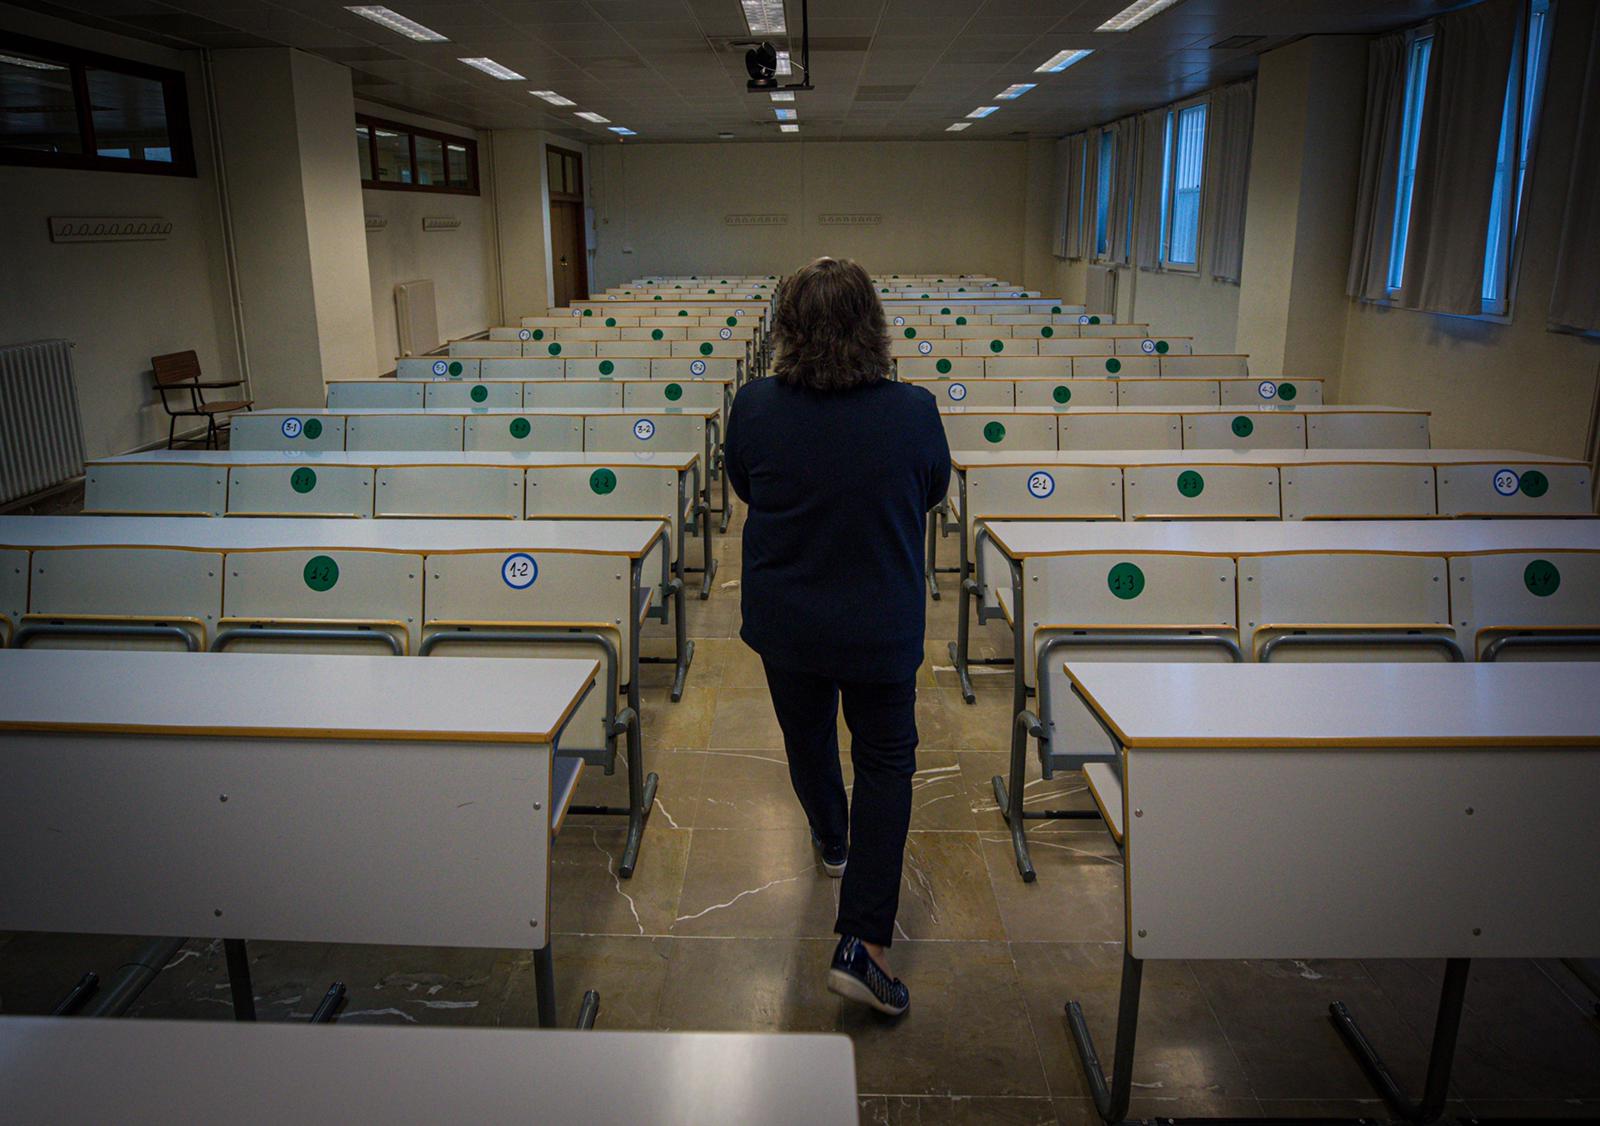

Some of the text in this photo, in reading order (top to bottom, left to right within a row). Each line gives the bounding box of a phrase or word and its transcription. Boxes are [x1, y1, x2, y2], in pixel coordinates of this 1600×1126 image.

[285, 422, 297, 432] 3-1
[637, 424, 651, 434] 3-2
[1032, 477, 1047, 490] 2-1
[1497, 476, 1512, 488] 2-2
[310, 566, 330, 582] 1-2
[509, 562, 529, 578] 1-2
[1113, 574, 1134, 591] 1-3
